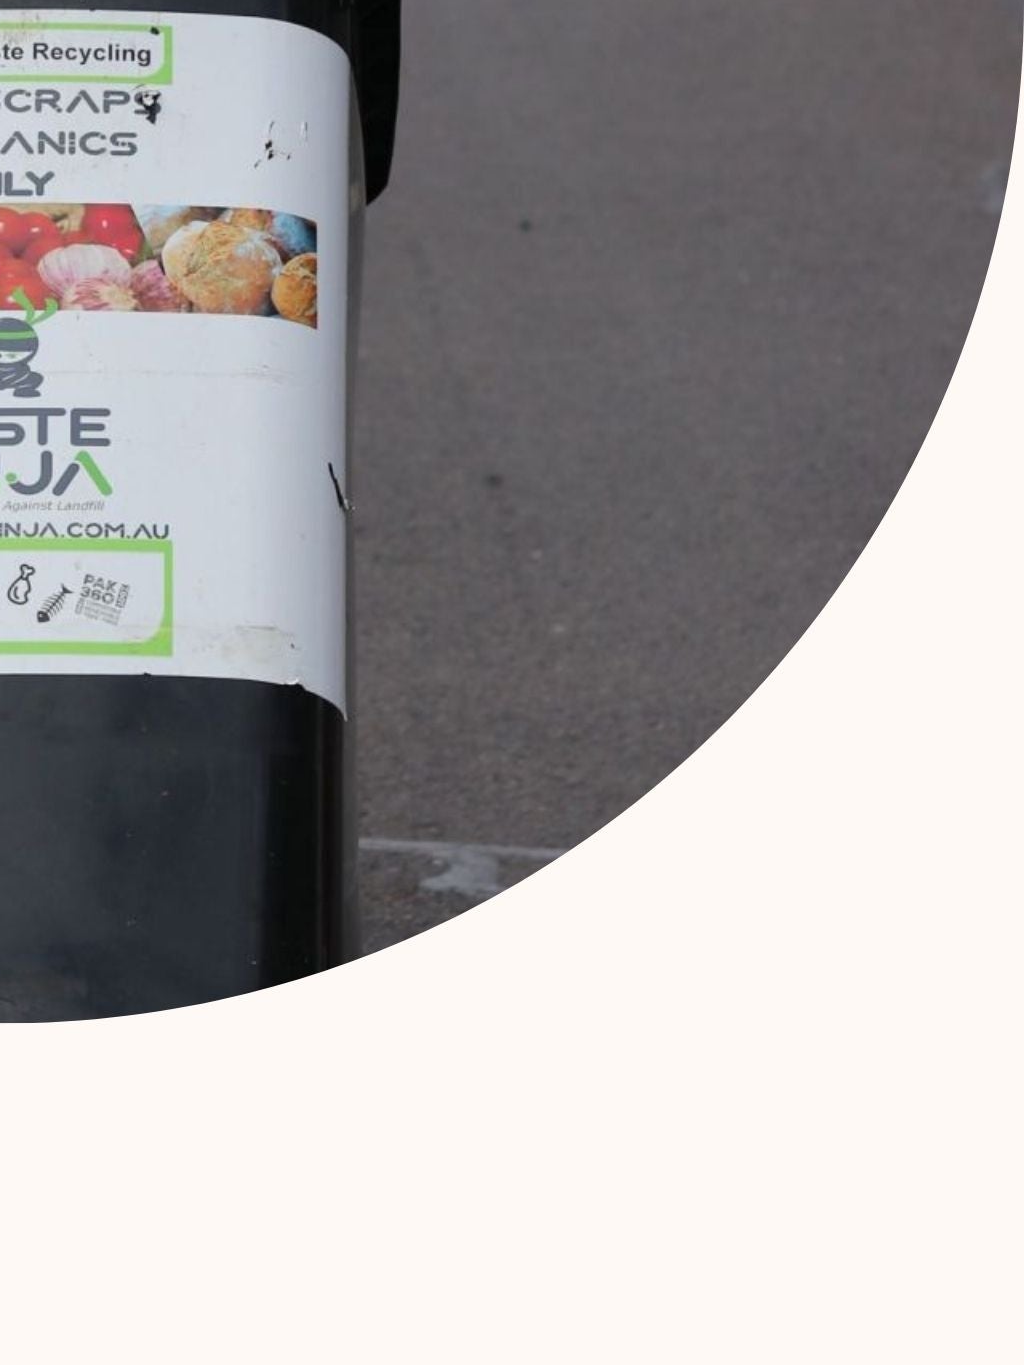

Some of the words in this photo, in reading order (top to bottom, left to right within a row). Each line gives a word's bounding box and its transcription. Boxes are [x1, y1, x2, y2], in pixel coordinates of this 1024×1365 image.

[32, 43, 152, 67] Recycling
[2, 500, 53, 512] Against
[57, 500, 106, 512] Landfill
[83, 573, 118, 592] PAK
[79, 585, 115, 605] 360
